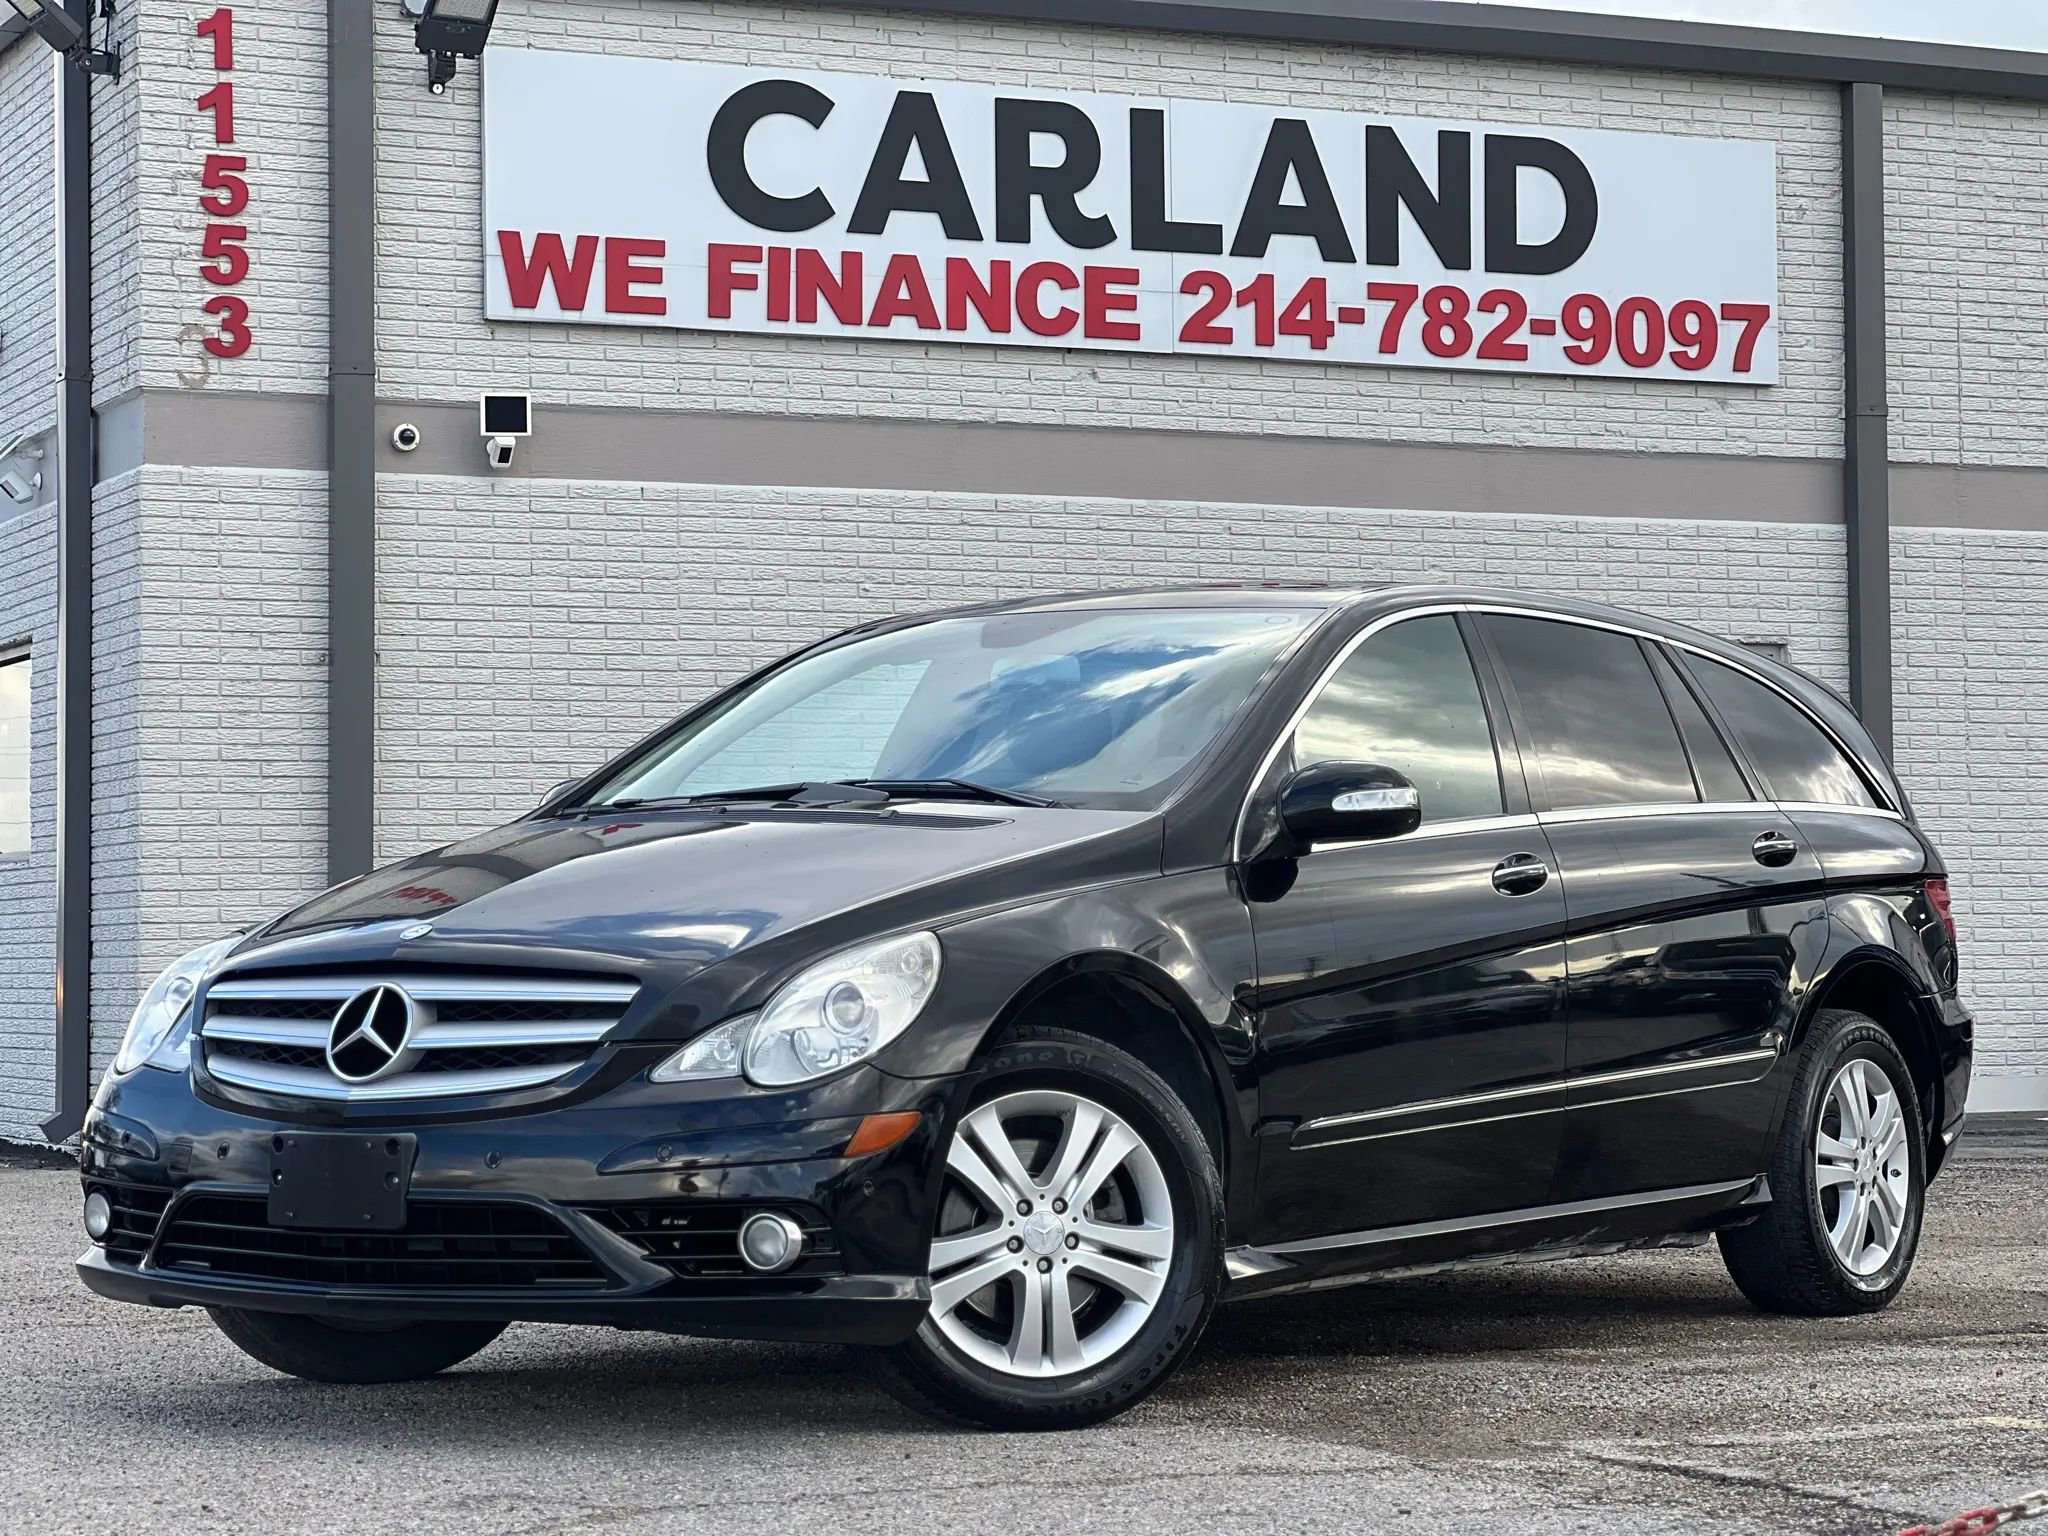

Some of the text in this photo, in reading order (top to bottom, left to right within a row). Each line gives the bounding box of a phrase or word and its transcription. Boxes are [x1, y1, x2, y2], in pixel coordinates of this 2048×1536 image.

[198, 9, 252, 358] 11553
[707, 79, 1598, 276] CARLAND
[497, 230, 1771, 371] WE FINANCE 214-782-9097
